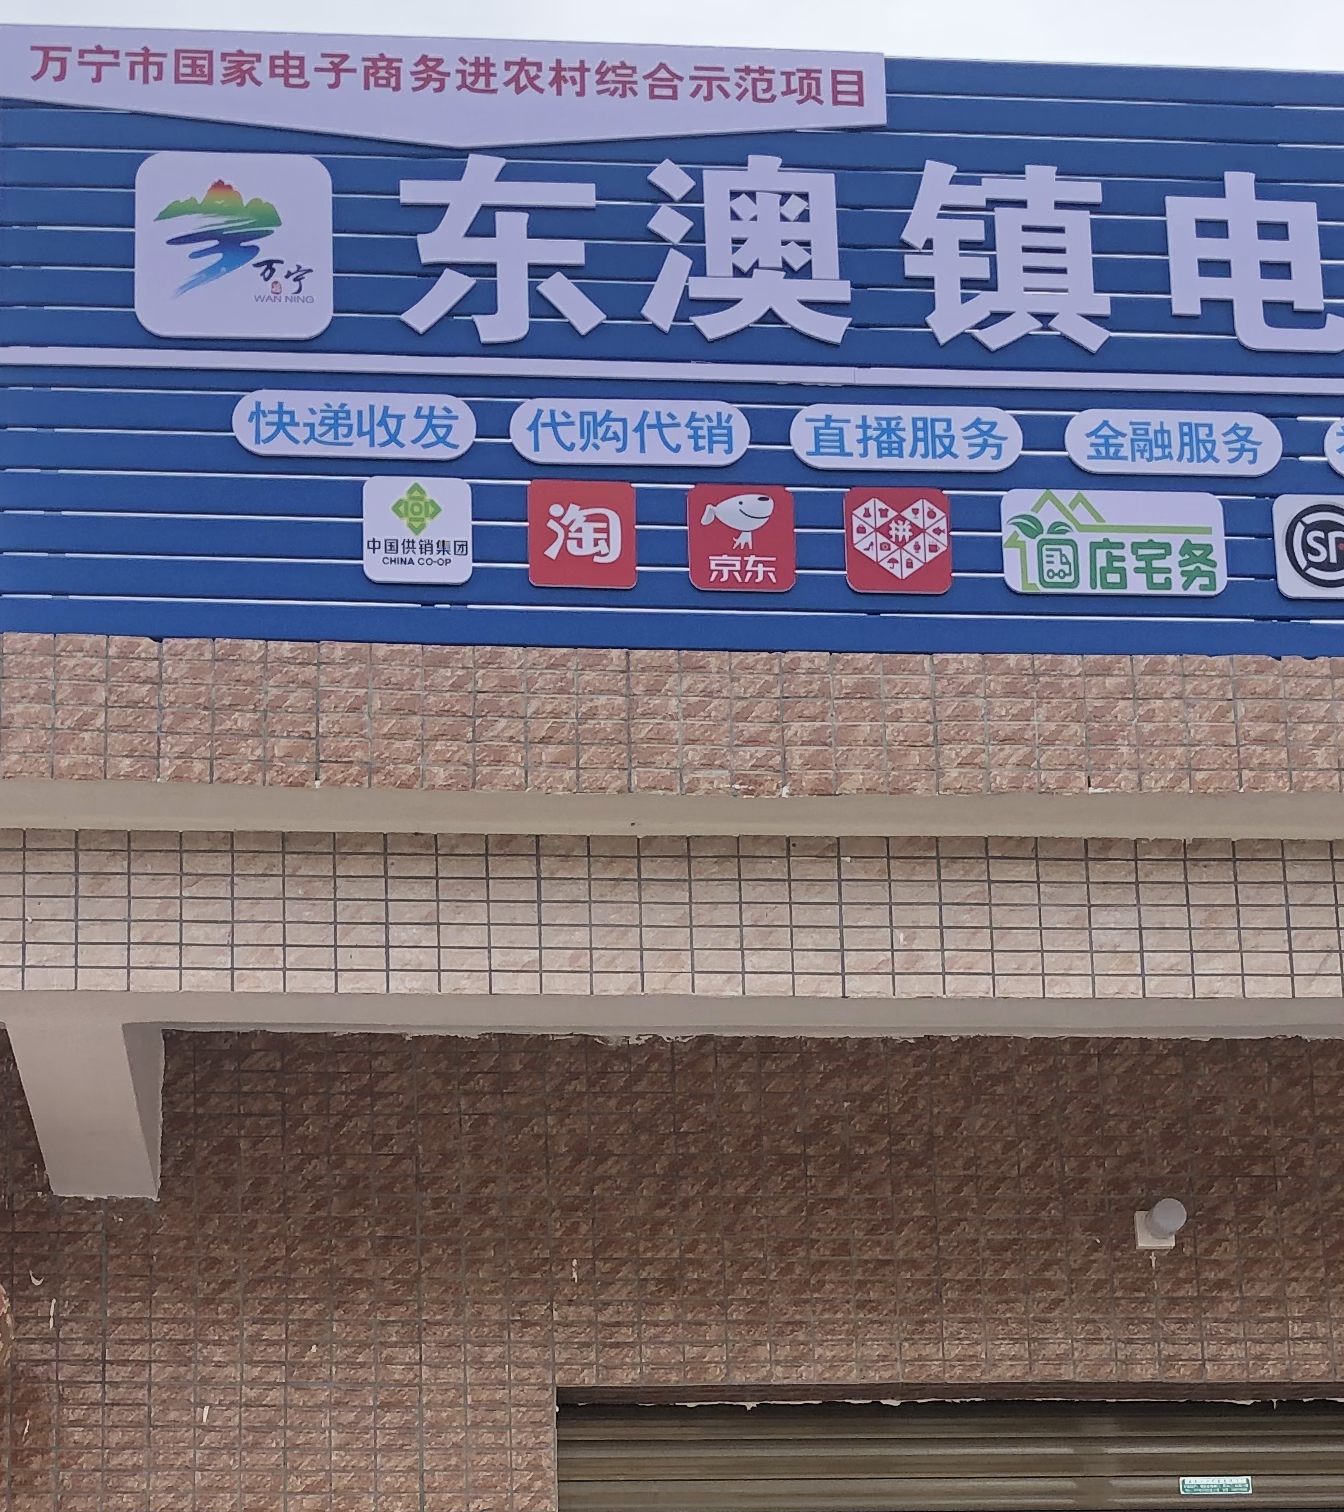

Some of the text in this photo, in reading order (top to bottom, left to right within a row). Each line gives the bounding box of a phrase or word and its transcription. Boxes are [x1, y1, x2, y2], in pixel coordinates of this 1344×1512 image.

[29, 44, 867, 108] 万宁市国家电子商务进农村综合示范项目
[254, 294, 315, 304] WAN NING
[249, 401, 460, 450] 快递收发
[526, 408, 735, 456] 代购代销
[805, 413, 1009, 461] 直播服务
[1084, 418, 1264, 467] 金融服务
[366, 537, 469, 556] 中国供销集团
[544, 503, 622, 564] 淘
[888, 518, 914, 544] 拼
[382, 556, 453, 567] CHINA CO-OP
[709, 554, 777, 583] 京东
